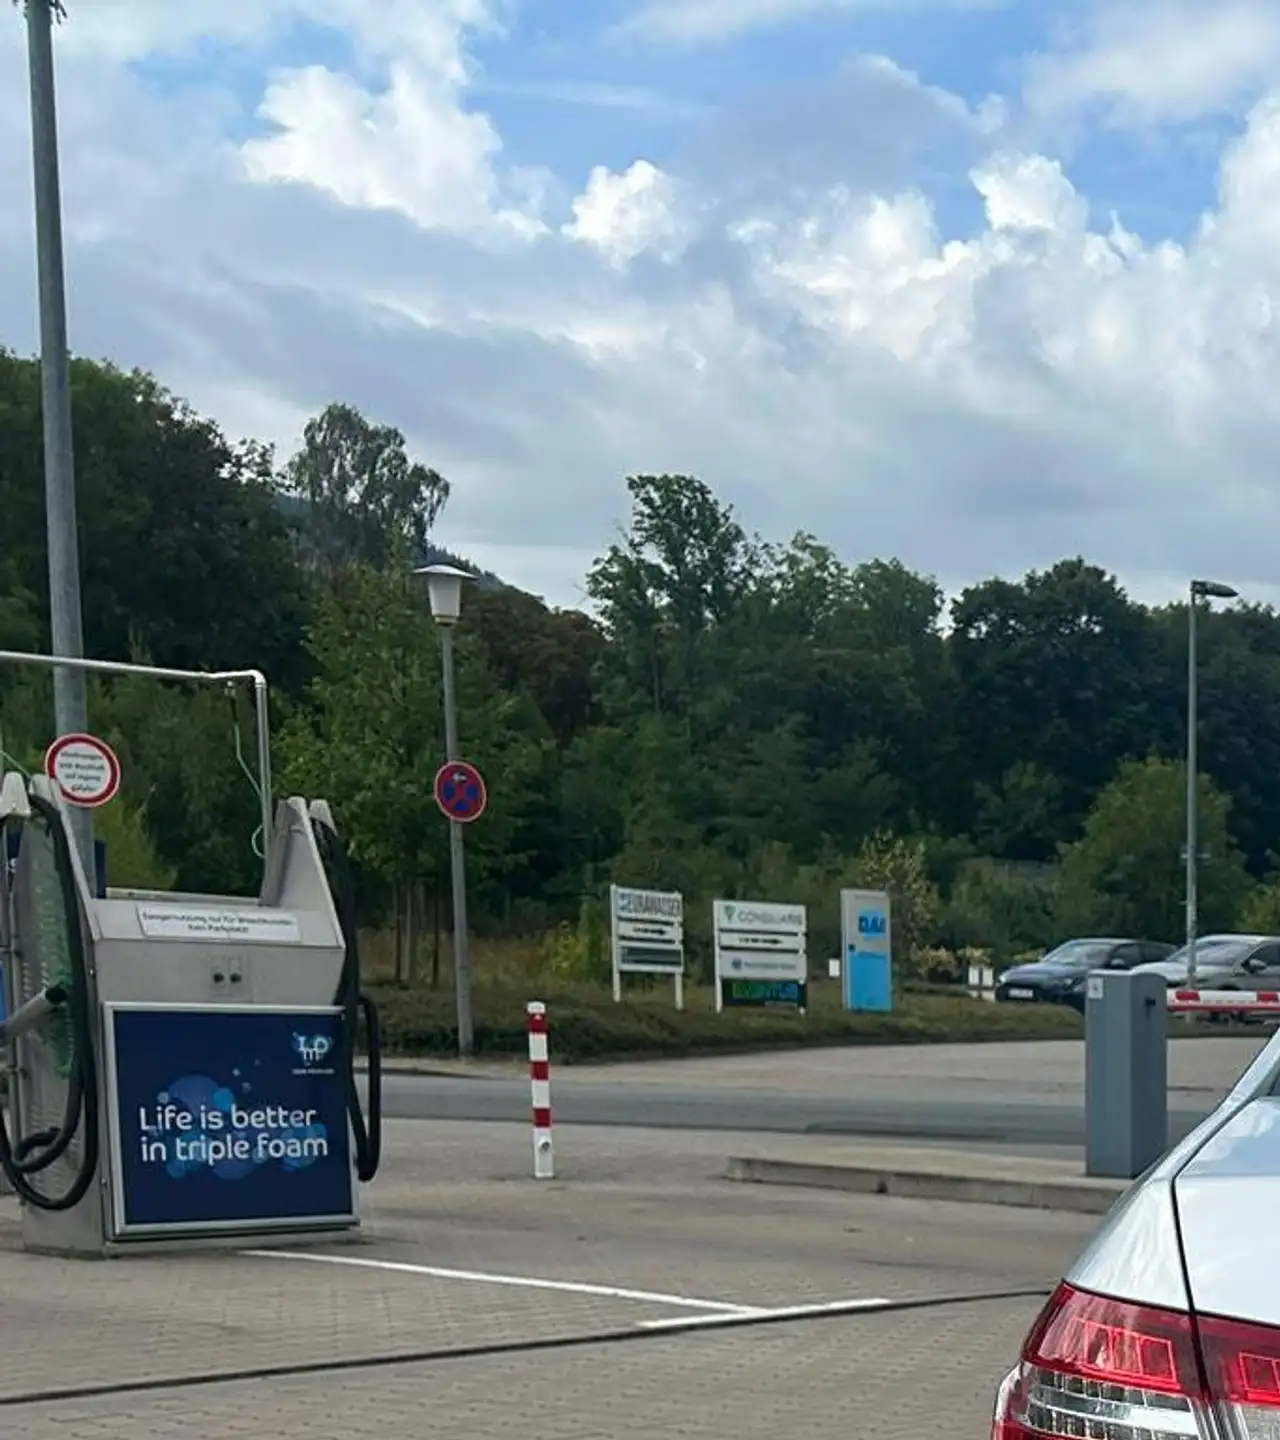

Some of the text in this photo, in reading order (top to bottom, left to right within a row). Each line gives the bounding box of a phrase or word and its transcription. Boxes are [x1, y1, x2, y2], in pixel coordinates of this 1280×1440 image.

[139, 1104, 317, 1131] Life is better
[140, 1132, 328, 1166] in triple foam
